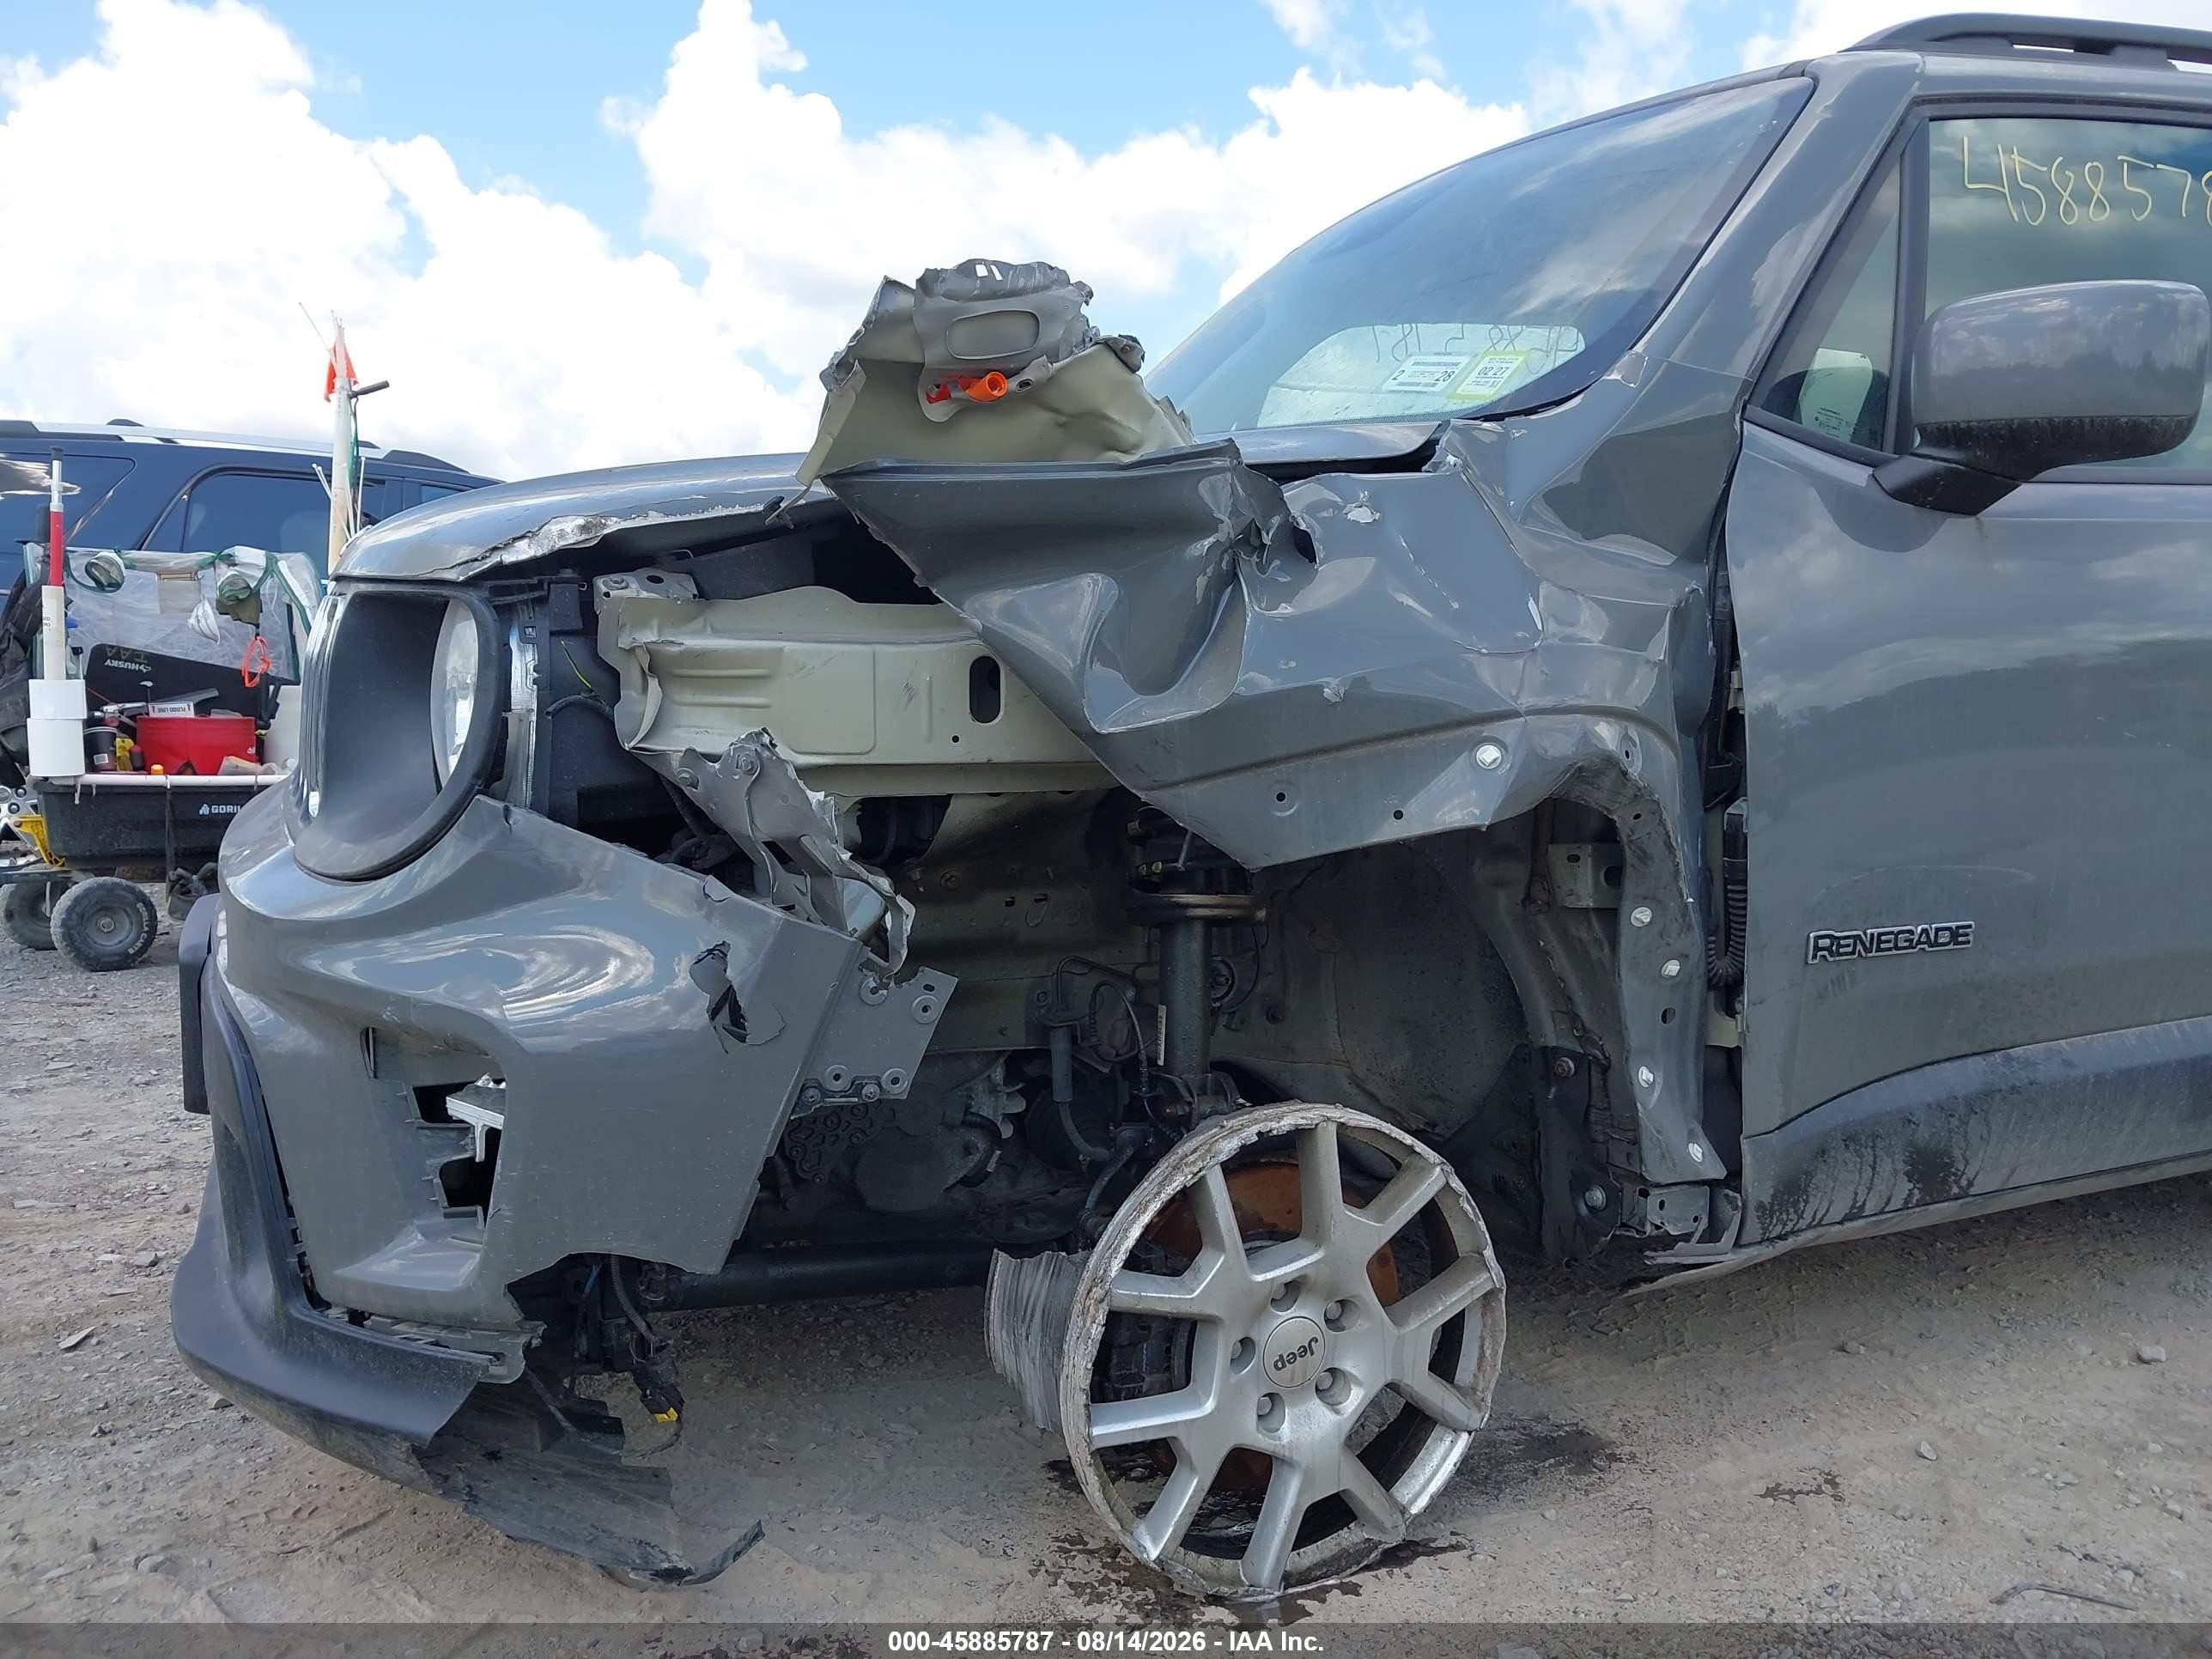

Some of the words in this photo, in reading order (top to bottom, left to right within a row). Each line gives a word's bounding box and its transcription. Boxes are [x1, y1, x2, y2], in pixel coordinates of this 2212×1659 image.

[1434, 370, 1455, 382] 28
[104, 659, 138, 671] HUSKY
[1807, 921, 1975, 963] RENEGADE
[1273, 1336, 1319, 1371] Jeep
